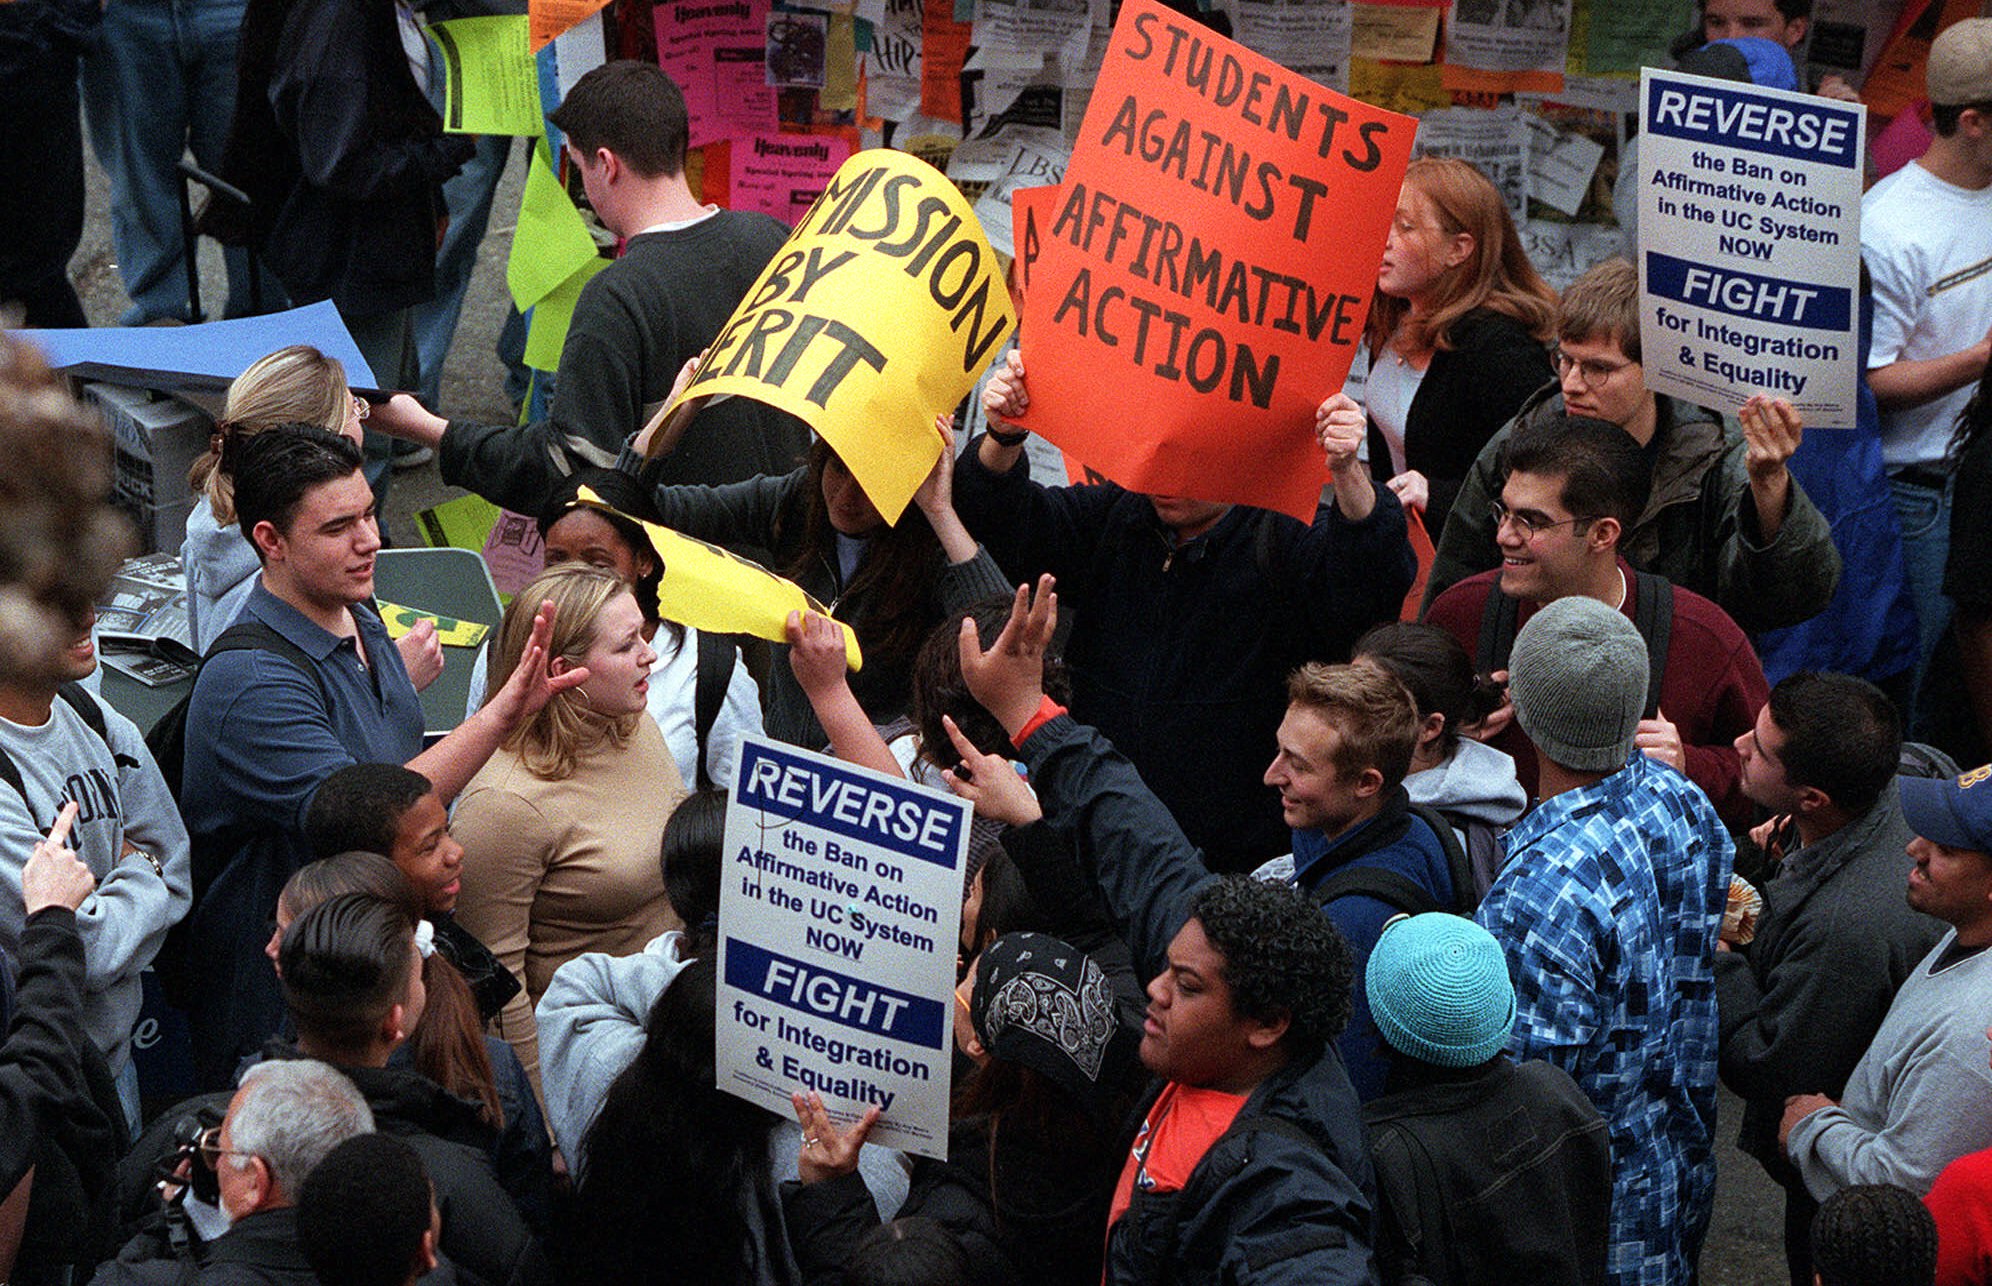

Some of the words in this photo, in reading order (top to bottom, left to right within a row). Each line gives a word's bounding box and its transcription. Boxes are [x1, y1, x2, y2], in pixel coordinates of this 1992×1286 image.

[1125, 12, 1388, 172] STUDENTS
[1656, 90, 1849, 154] REVERSE
[754, 137, 829, 161] Heavenly
[1102, 96, 1328, 243] AGAINST
[1692, 151, 1726, 171] the
[1732, 158, 1773, 180] Ban
[1780, 170, 1807, 186] on
[1651, 170, 1766, 205] Affirmative
[1771, 192, 1841, 218] Action
[1658, 197, 1676, 216] in
[1682, 203, 1715, 223] the
[1722, 210, 1753, 230] UC
[1759, 217, 1839, 245] System
[743, 246, 860, 315] BY
[791, 167, 1007, 373] MISSION
[1052, 183, 1361, 345] AFFIRMATIVE
[1719, 235, 1773, 260] NOW
[1682, 268, 1818, 321] FIGHT
[684, 309, 888, 410] ERIT
[1053, 268, 1280, 409] ACTION
[1656, 307, 1690, 333] for
[1697, 319, 1839, 360] Integration
[1679, 346, 1696, 367] &
[1703, 352, 1807, 396] Equality
[747, 757, 953, 851] REVERSE
[736, 846, 859, 898] Affirmative
[864, 886, 938, 923] Action
[783, 829, 817, 855] the
[825, 843, 868, 871] Ban
[875, 861, 903, 882] on
[742, 877, 762, 899] in
[769, 886, 803, 912] the
[810, 899, 843, 924] UC
[850, 911, 934, 953] System
[806, 926, 864, 959] NOW
[763, 960, 909, 1031] FIGHT
[733, 1001, 771, 1031] for
[778, 1017, 930, 1080] Integration
[755, 1046, 774, 1071] &
[782, 1055, 896, 1112] Equality
